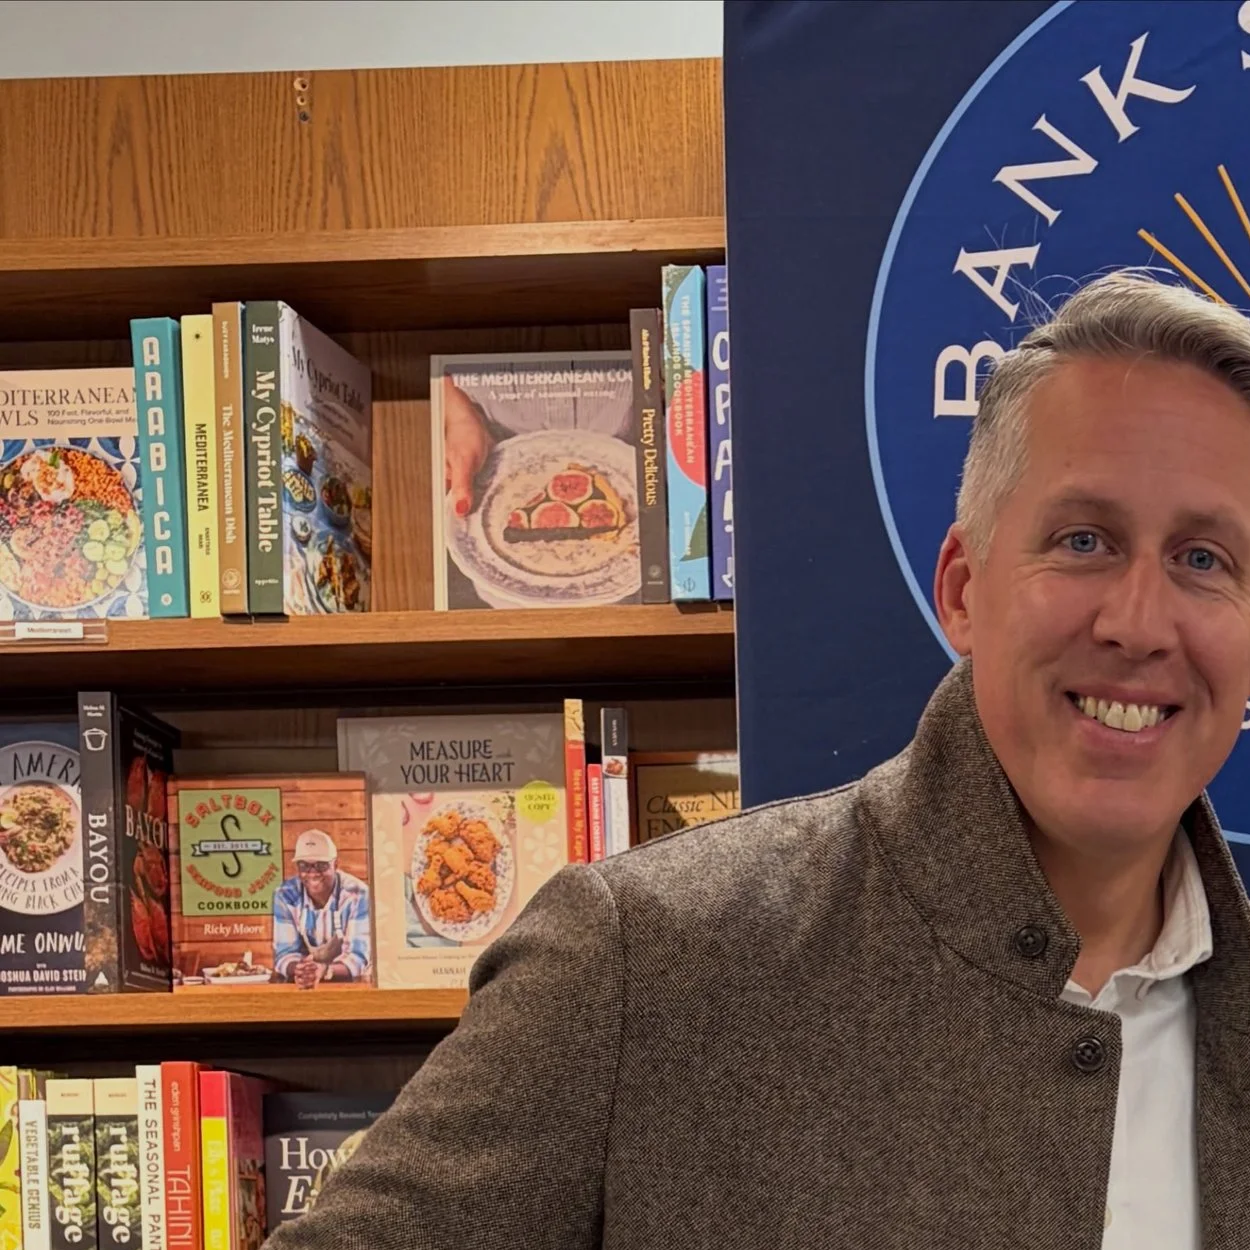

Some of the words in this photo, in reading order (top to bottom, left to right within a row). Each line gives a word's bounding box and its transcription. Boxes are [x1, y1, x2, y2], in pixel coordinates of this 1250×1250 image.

[933, 32, 1196, 419] BANK
[251, 370, 275, 402] My
[482, 370, 604, 386] MEDITERRANEAN
[222, 404, 234, 427] The
[642, 409, 656, 446] Pretty
[673, 373, 683, 437] COOKBOOK
[683, 369, 695, 464] MEDITERRANEAN
[195, 423, 209, 512] MEDITERRANEA
[223, 430, 235, 514] Mediterranean
[251, 406, 276, 489] Cypriot
[644, 449, 657, 505] Delicious
[225, 517, 237, 544] Dish
[258, 492, 279, 553] Table
[401, 763, 449, 785] YOUR
[454, 762, 516, 783] HEART
[410, 739, 493, 761] MEASURE
[184, 794, 276, 829] SALTBOX
[647, 793, 704, 813] Classic
[88, 813, 110, 905] BAYOU
[198, 901, 268, 911] COOKBOOK
[204, 924, 232, 936] Ricky
[233, 924, 265, 935] Moore
[33, 970, 60, 982] DAVID
[144, 1079, 157, 1110] THE
[25, 1120, 40, 1185] VEGETABLE
[145, 1118, 159, 1205] SEASONAL
[28, 1186, 41, 1230] GENIUS
[55, 1126, 89, 1244] ruffage
[103, 1126, 138, 1244] ruffage
[167, 1164, 192, 1246] TAHINI
